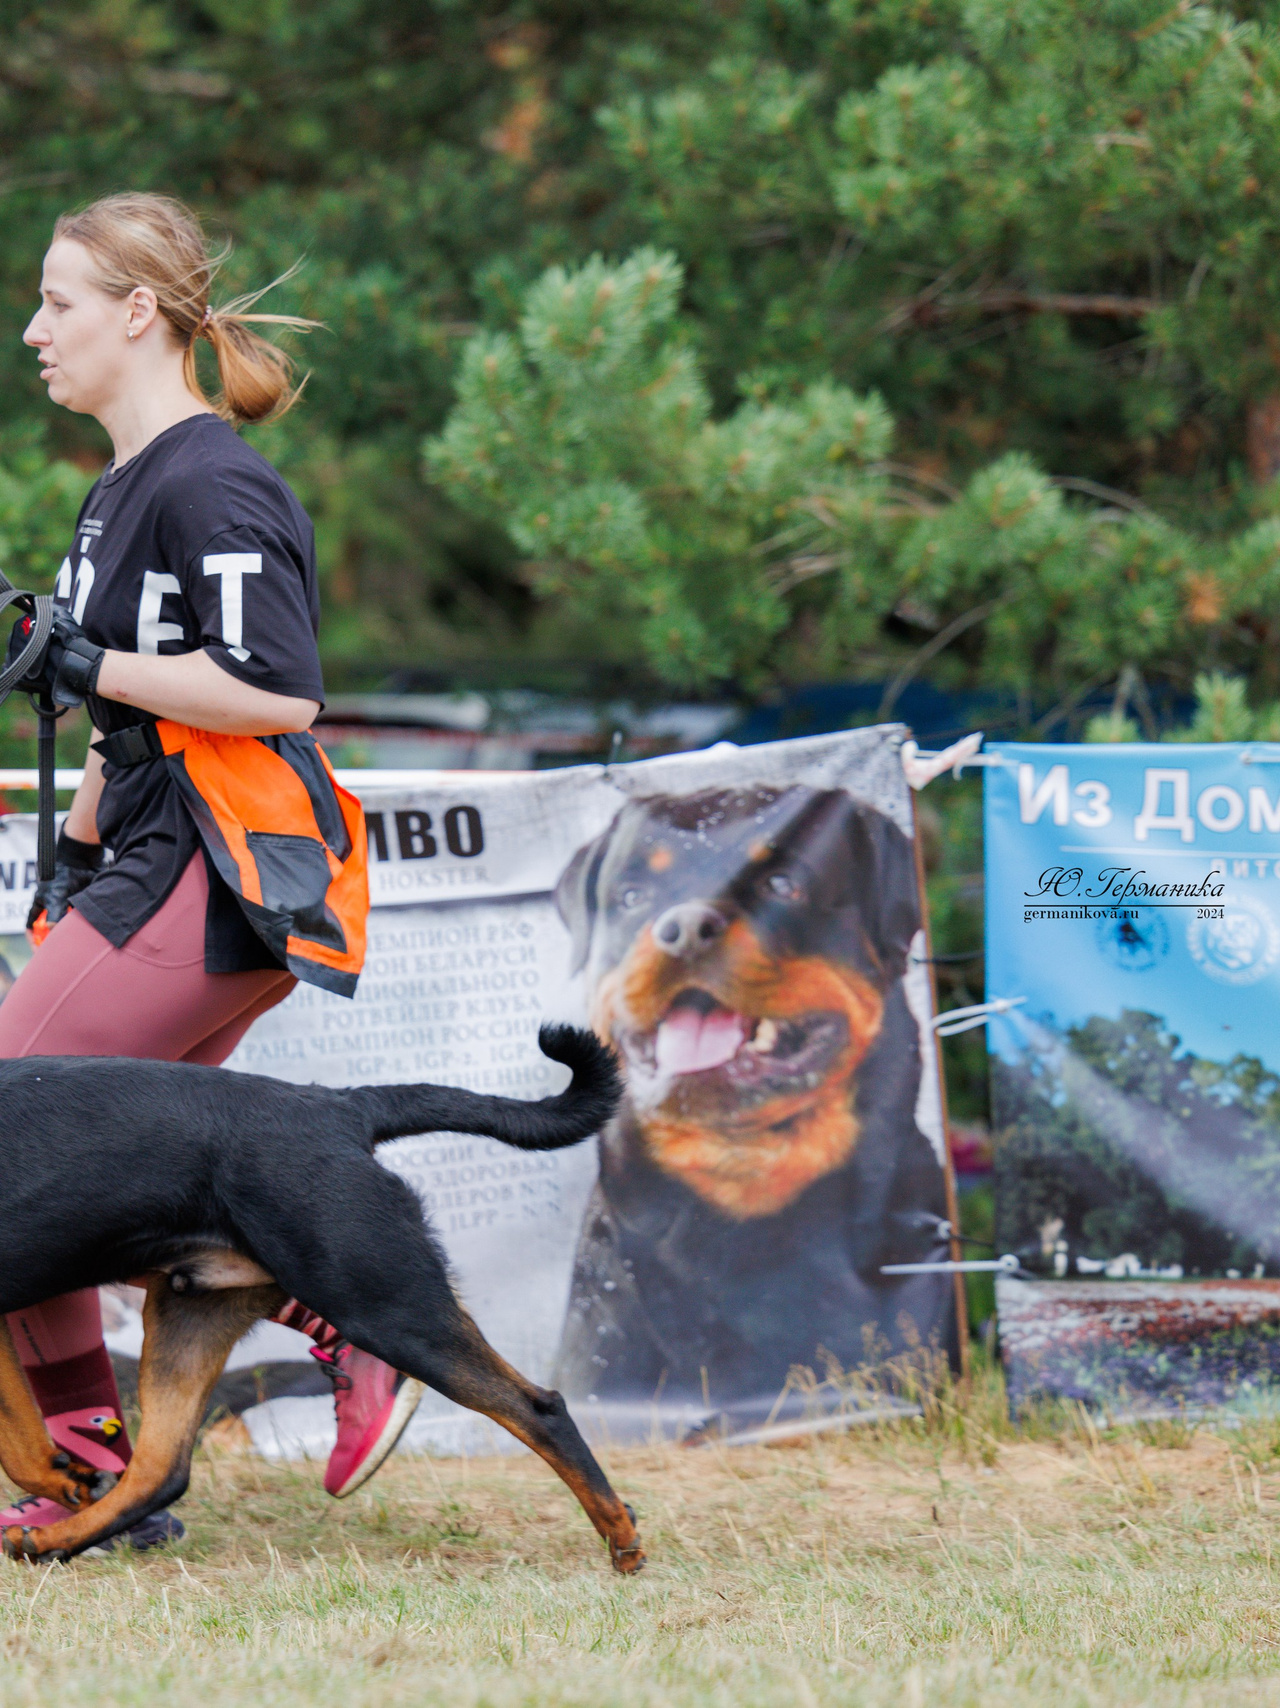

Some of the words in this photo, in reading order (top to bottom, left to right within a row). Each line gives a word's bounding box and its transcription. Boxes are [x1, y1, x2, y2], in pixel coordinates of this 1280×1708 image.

[1019, 763, 1113, 828] Из
[379, 866, 490, 891] HOKSTER
[310, 1025, 435, 1055] ЧЕМПИОН
